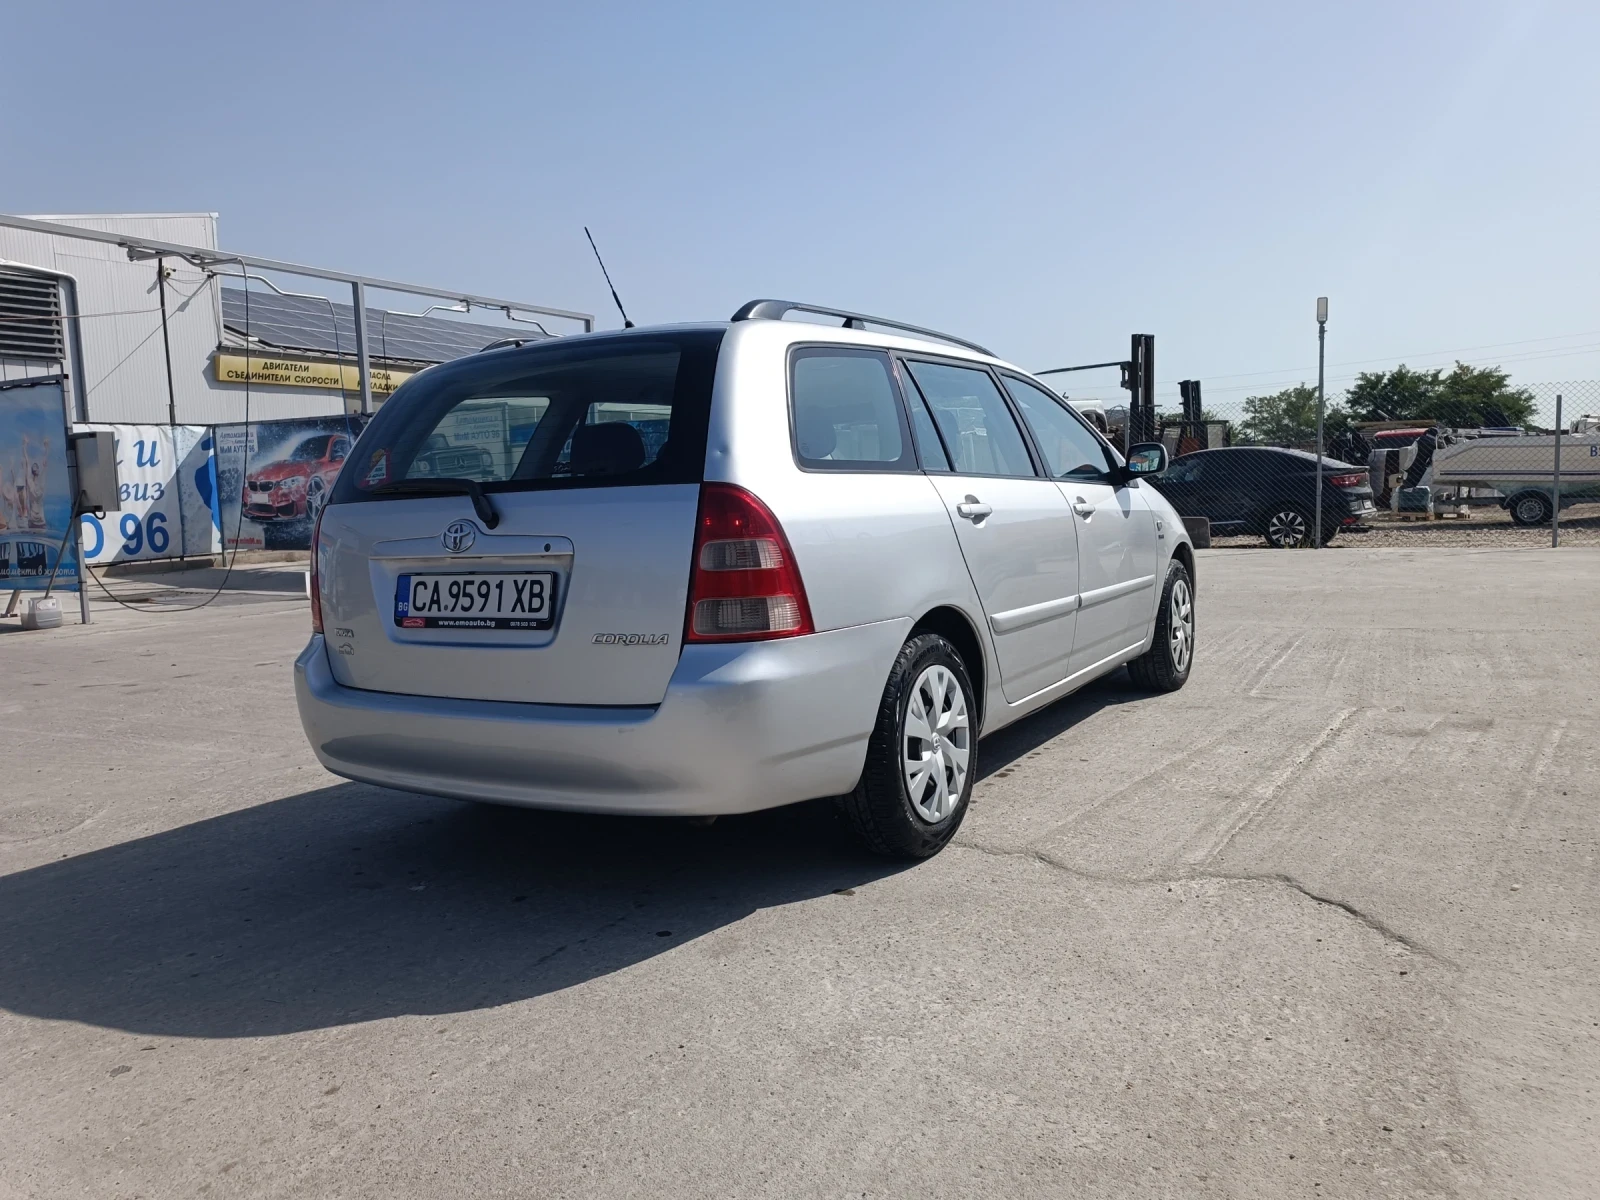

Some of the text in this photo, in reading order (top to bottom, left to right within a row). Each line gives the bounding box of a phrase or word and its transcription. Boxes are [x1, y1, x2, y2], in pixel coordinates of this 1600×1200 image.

[262, 361, 310, 372] ДВИГАТЕЛИ
[226, 369, 339, 385] СЪЕДИНИТЕЛИ СКОРОСТИ
[1590, 445, 1600, 457] B
[119, 511, 170, 556] 96
[398, 602, 408, 611] BG
[438, 619, 496, 627] www.emoauto.bg
[591, 633, 669, 646] COROLLA
